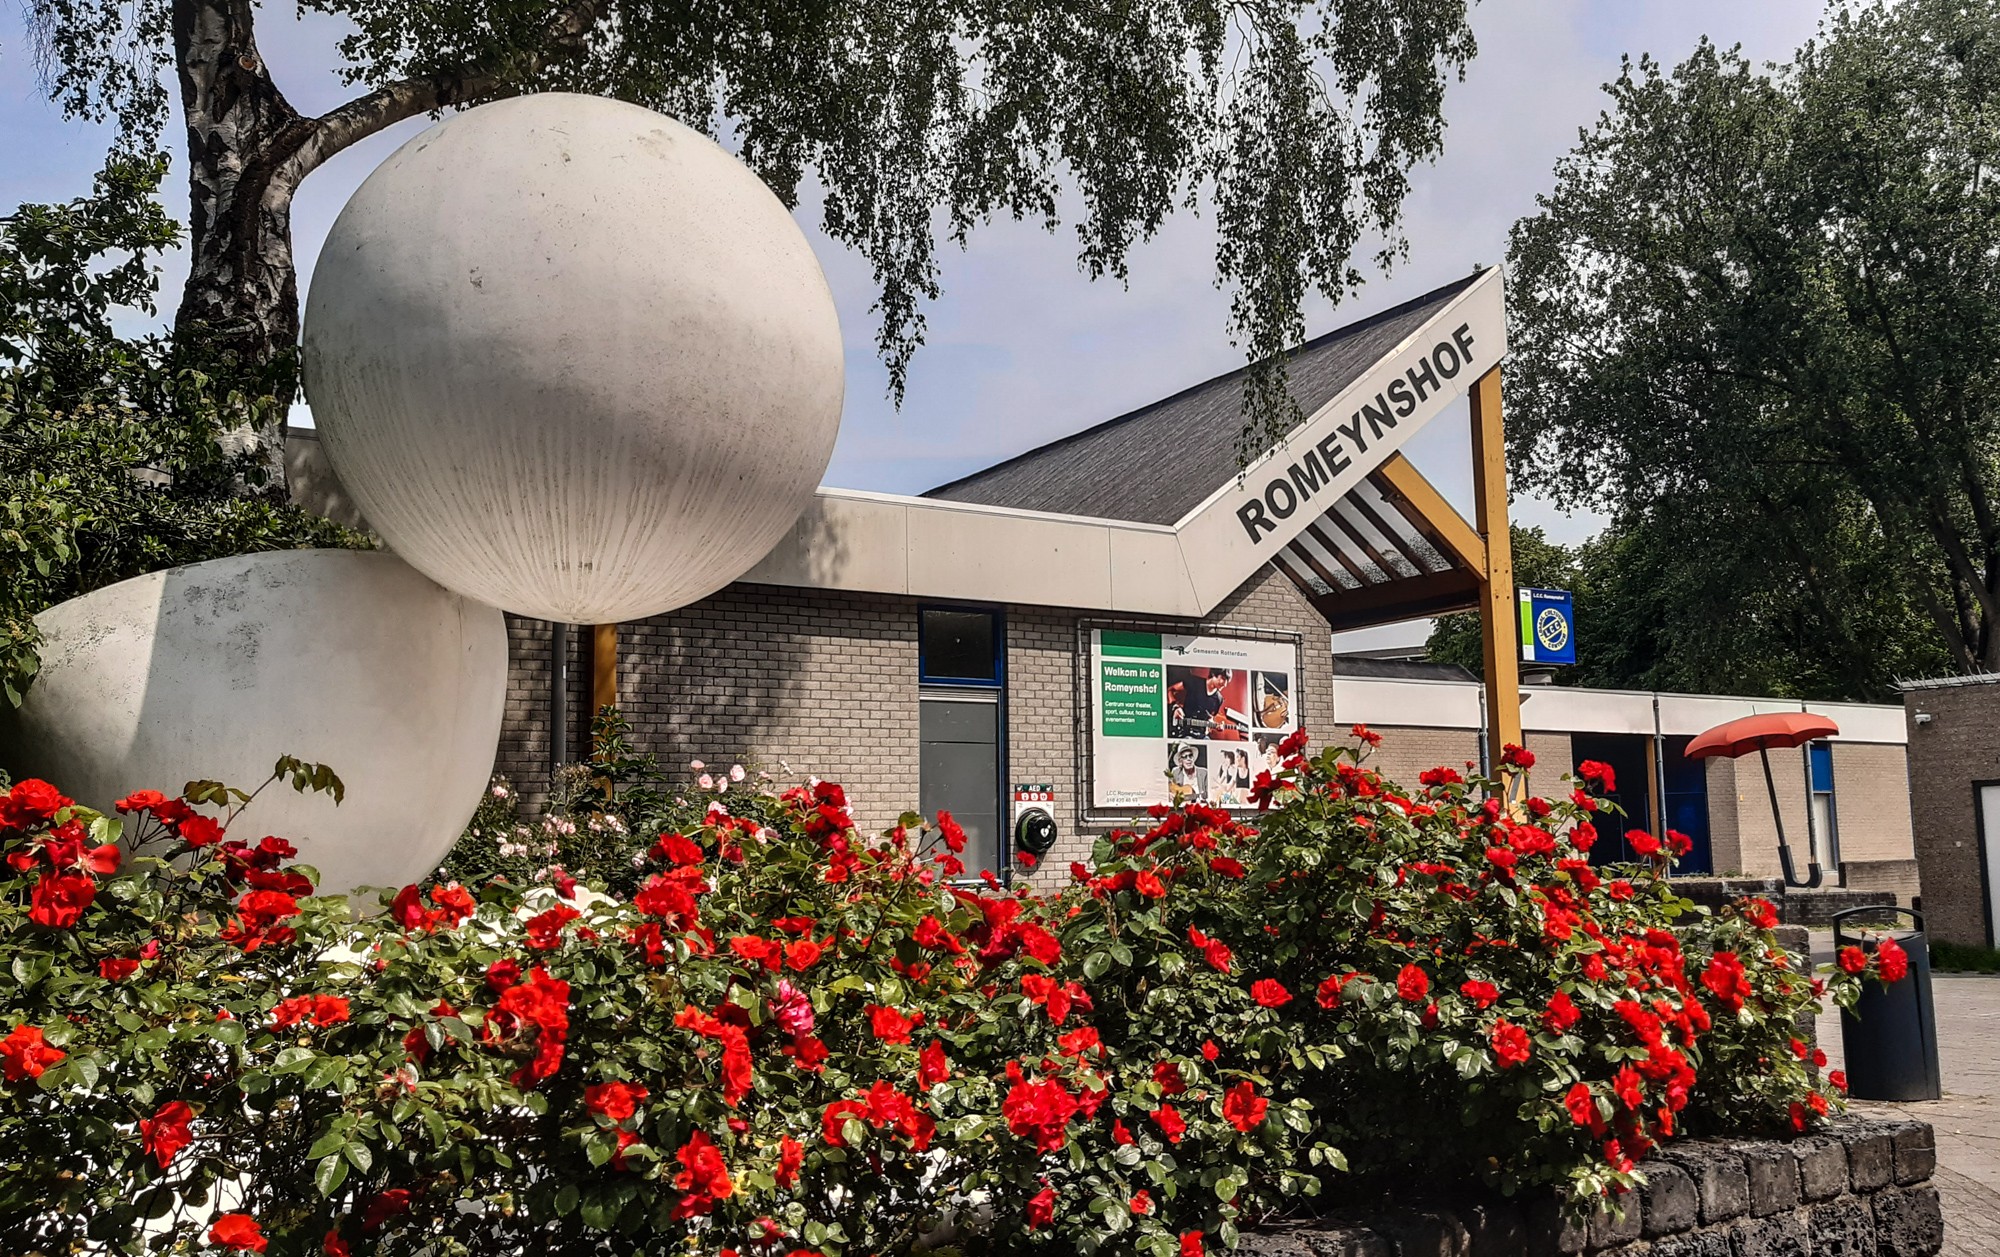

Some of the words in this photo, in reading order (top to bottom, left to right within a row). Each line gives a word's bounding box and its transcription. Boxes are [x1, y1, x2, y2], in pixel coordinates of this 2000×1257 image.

[1235, 322, 1475, 545] ROMEYNSHOF
[1545, 622, 1560, 636] LCC
[1192, 647, 1219, 655] Gemeente
[1220, 649, 1248, 657] Rotterdam
[1104, 666, 1138, 677] Welkom
[1139, 668, 1148, 678] in
[1149, 668, 1160, 678] de
[1104, 682, 1158, 695] Romeynshof
